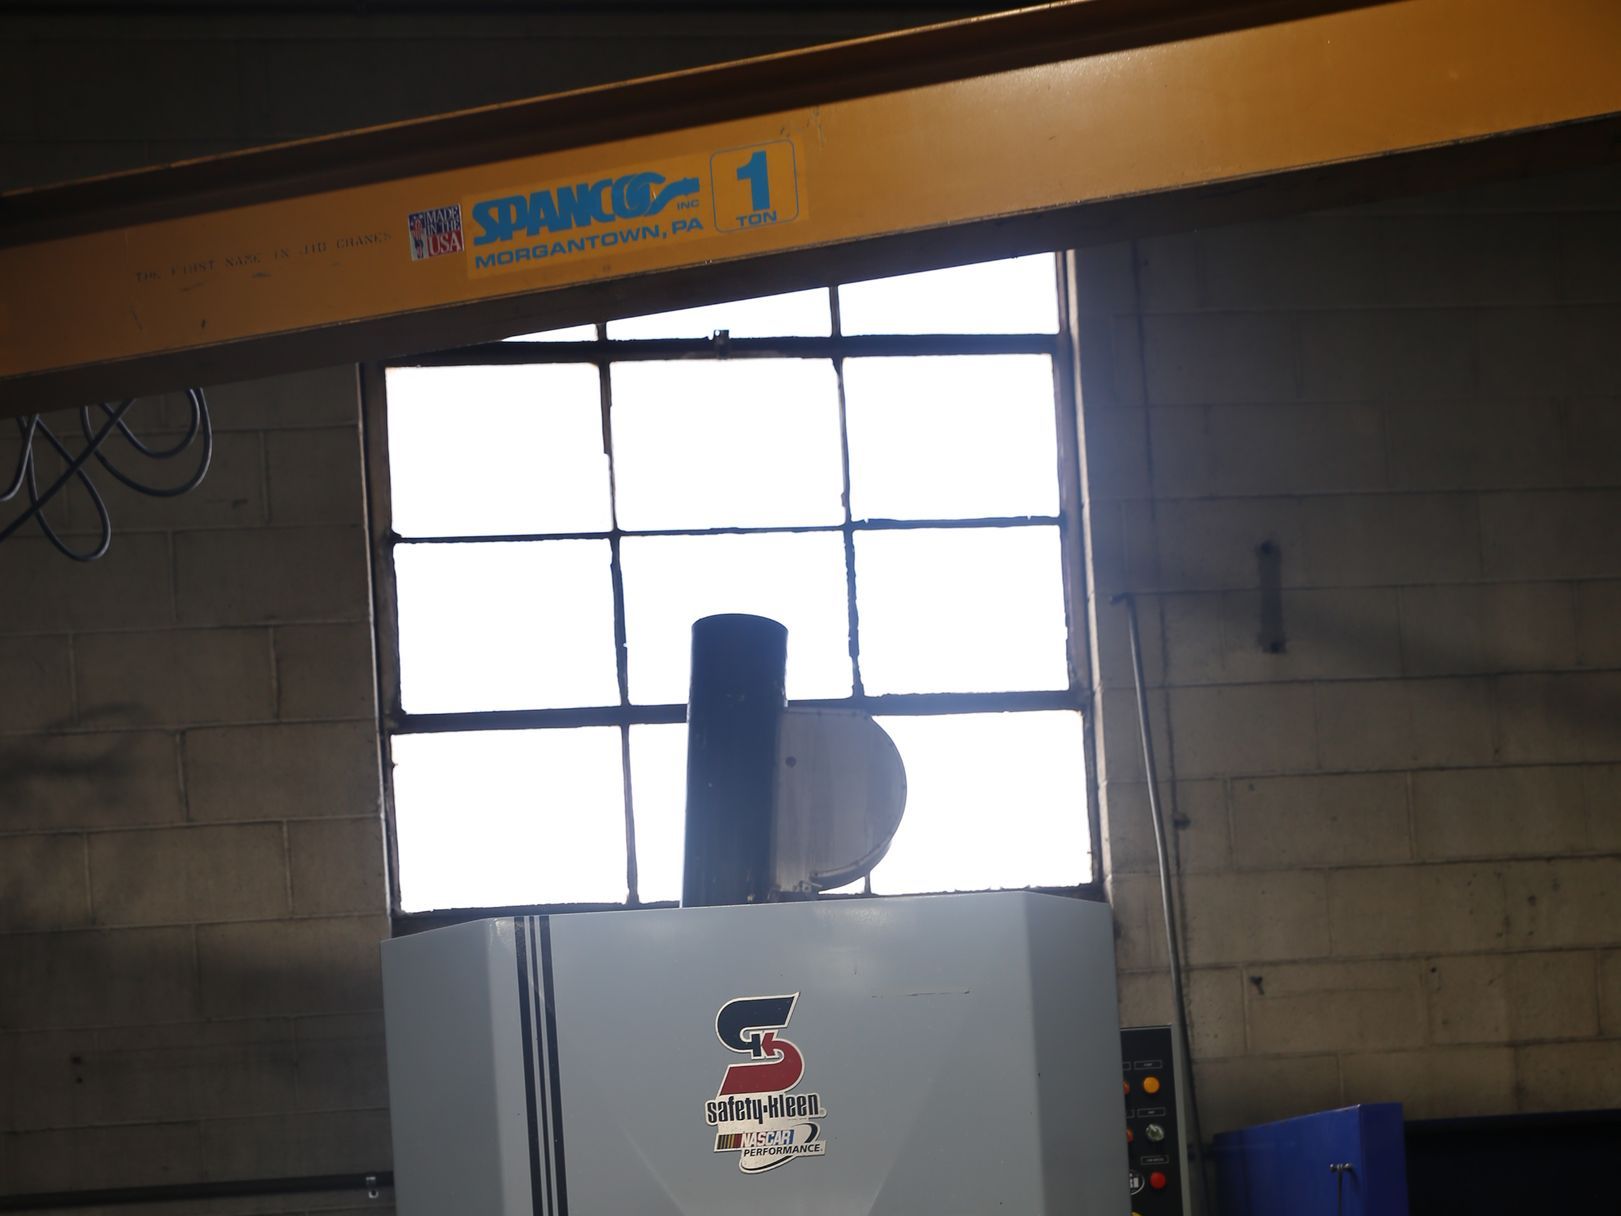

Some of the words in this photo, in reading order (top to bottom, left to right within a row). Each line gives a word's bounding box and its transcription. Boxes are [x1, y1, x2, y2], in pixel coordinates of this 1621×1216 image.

[735, 150, 772, 212] 1
[472, 171, 700, 246] SPANCO
[677, 199, 700, 212] INC
[426, 207, 459, 225] MADE
[736, 210, 778, 228] TON
[427, 222, 438, 236] IN
[440, 219, 461, 234] THE
[671, 216, 704, 235] PA
[428, 231, 463, 256] USA
[741, 1129, 794, 1148] NASCAR
[743, 1144, 821, 1158] PERFORMANCE
